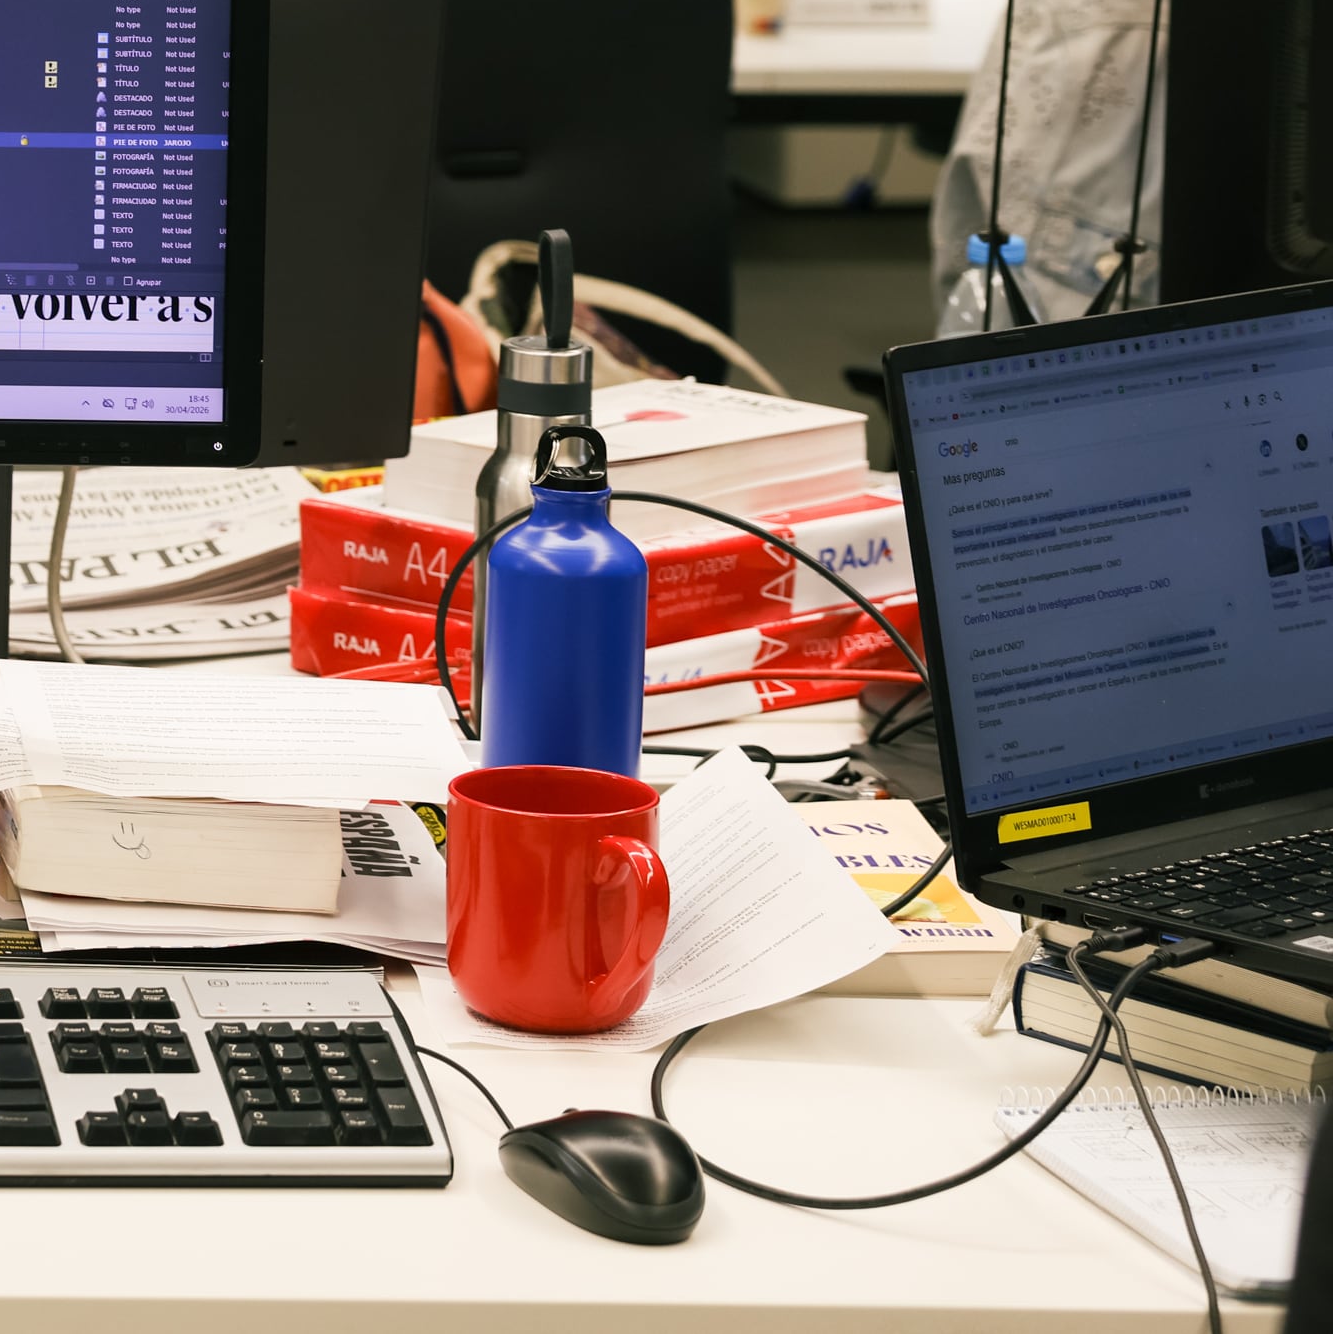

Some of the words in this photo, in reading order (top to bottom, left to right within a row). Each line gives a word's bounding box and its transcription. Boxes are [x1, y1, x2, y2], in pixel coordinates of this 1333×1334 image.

[115, 35, 152, 43] SUBTÍTULO
[115, 64, 139, 72] TÍTULO
[113, 153, 154, 161] FOTOGRAFÍA
[157, 297, 183, 322] a
[165, 406, 209, 414] 30/04/2026
[189, 395, 209, 403] 18:45
[938, 439, 978, 458] Google
[963, 467, 1005, 484] preguntas
[132, 538, 225, 569] EL
[343, 540, 389, 564] RAJA
[403, 542, 449, 588] A4
[819, 538, 893, 574] RAJA
[9, 554, 127, 586] PAI
[656, 562, 689, 583] copy
[696, 554, 740, 577] paper
[964, 612, 989, 625] Centro
[992, 605, 1025, 621] Nacional
[333, 632, 381, 656] RAJA
[340, 811, 421, 877] ESPAÑA
